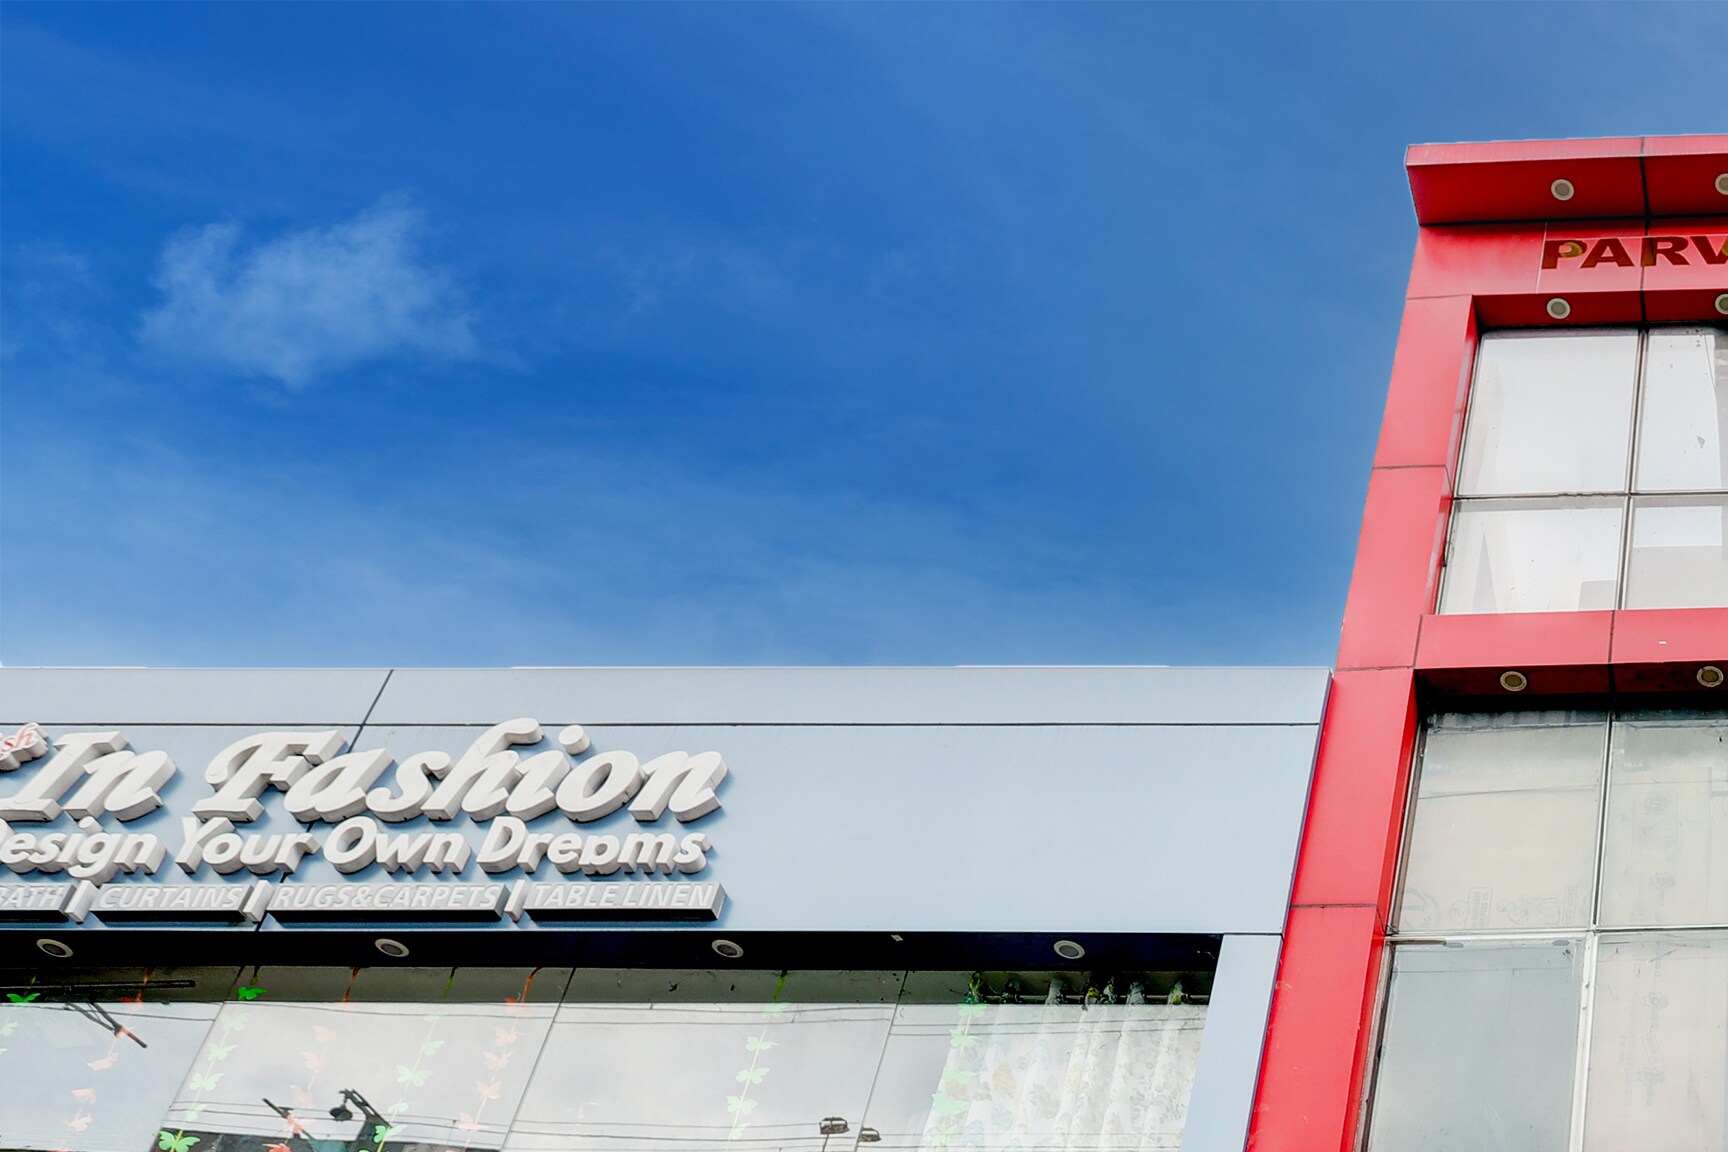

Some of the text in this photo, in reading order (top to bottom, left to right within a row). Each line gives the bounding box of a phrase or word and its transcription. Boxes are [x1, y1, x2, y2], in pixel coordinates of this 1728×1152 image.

[0, 718, 729, 823] In Fashion
[174, 815, 321, 876] Your
[323, 816, 472, 876] Own
[0, 884, 716, 910] ATH CURTAINS RUGS&CARPETS TABLE LINEN
